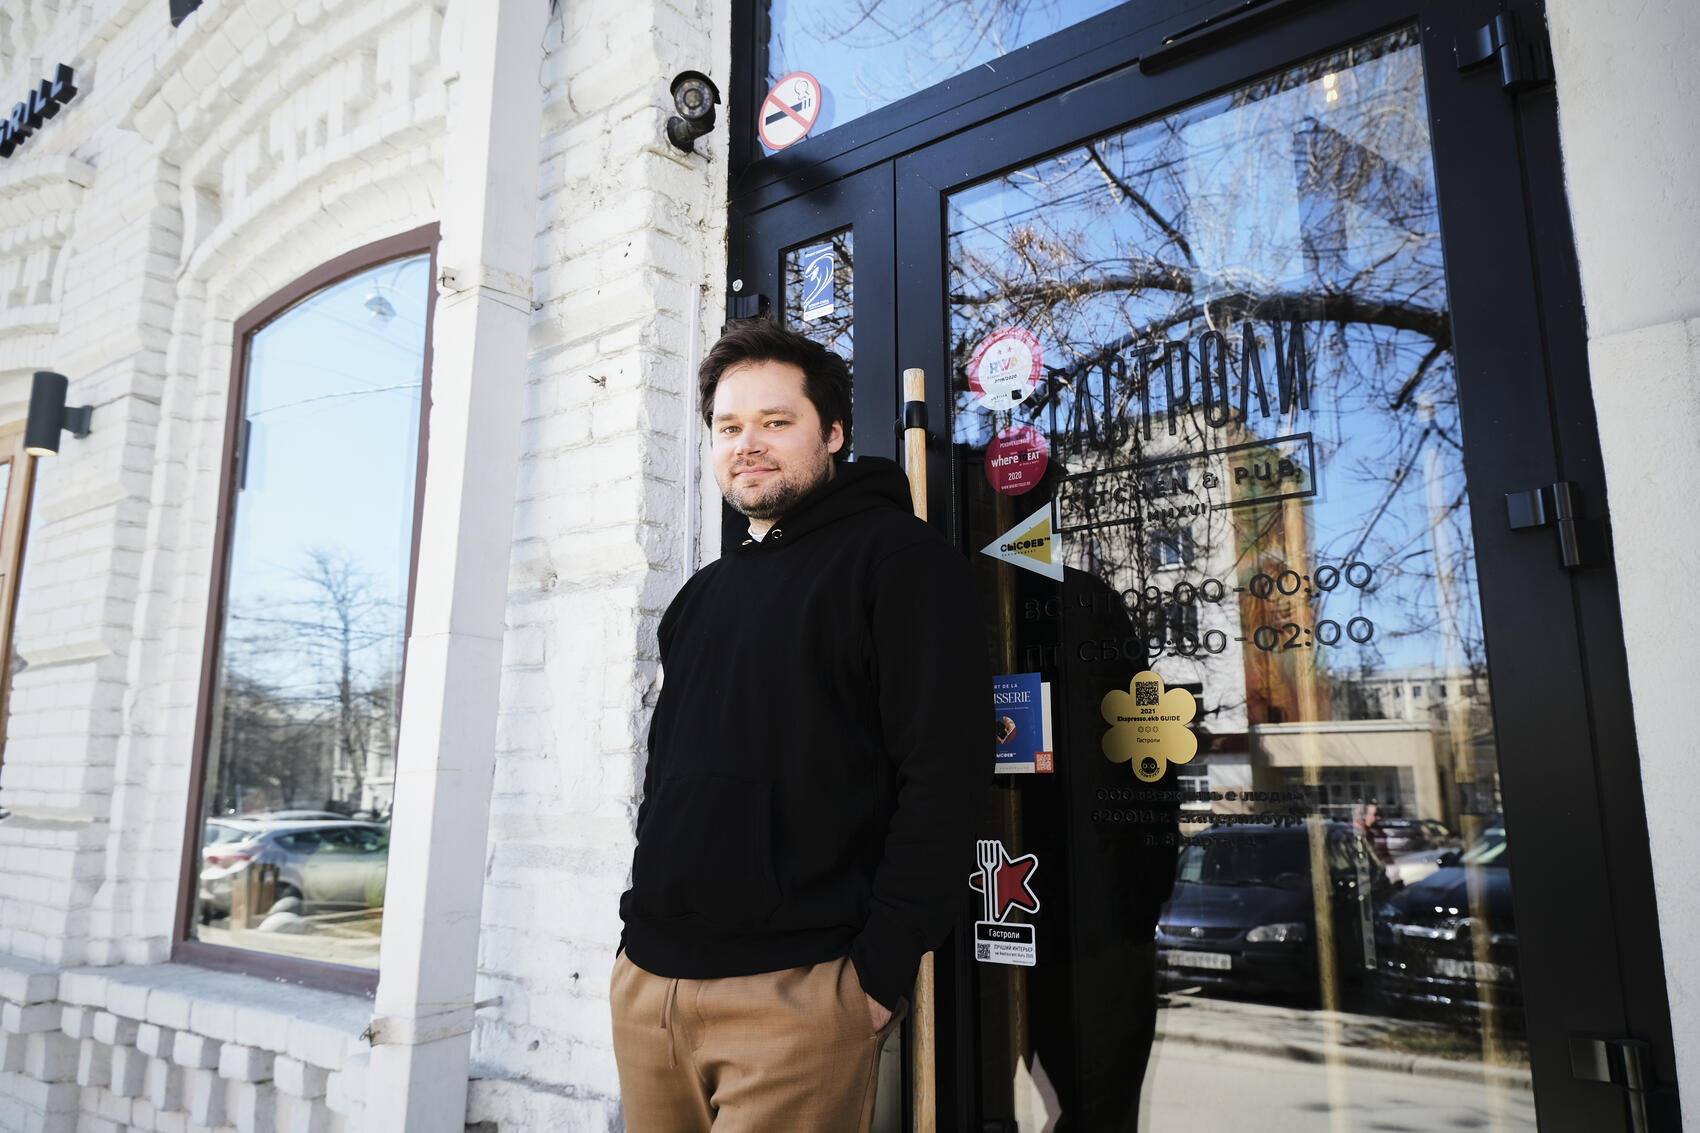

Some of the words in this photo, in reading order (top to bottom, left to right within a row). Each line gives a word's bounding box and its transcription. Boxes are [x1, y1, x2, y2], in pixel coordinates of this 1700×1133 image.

[1048, 312, 1310, 457] ГАСТРОЛИ
[1008, 471, 1022, 481] 2020
[1202, 472, 1218, 489] &
[1235, 459, 1295, 485] PUB
[1147, 503, 1207, 522] MMXVI
[993, 691, 1031, 704] ISSERIE
[989, 928, 1020, 940] Гастроли
